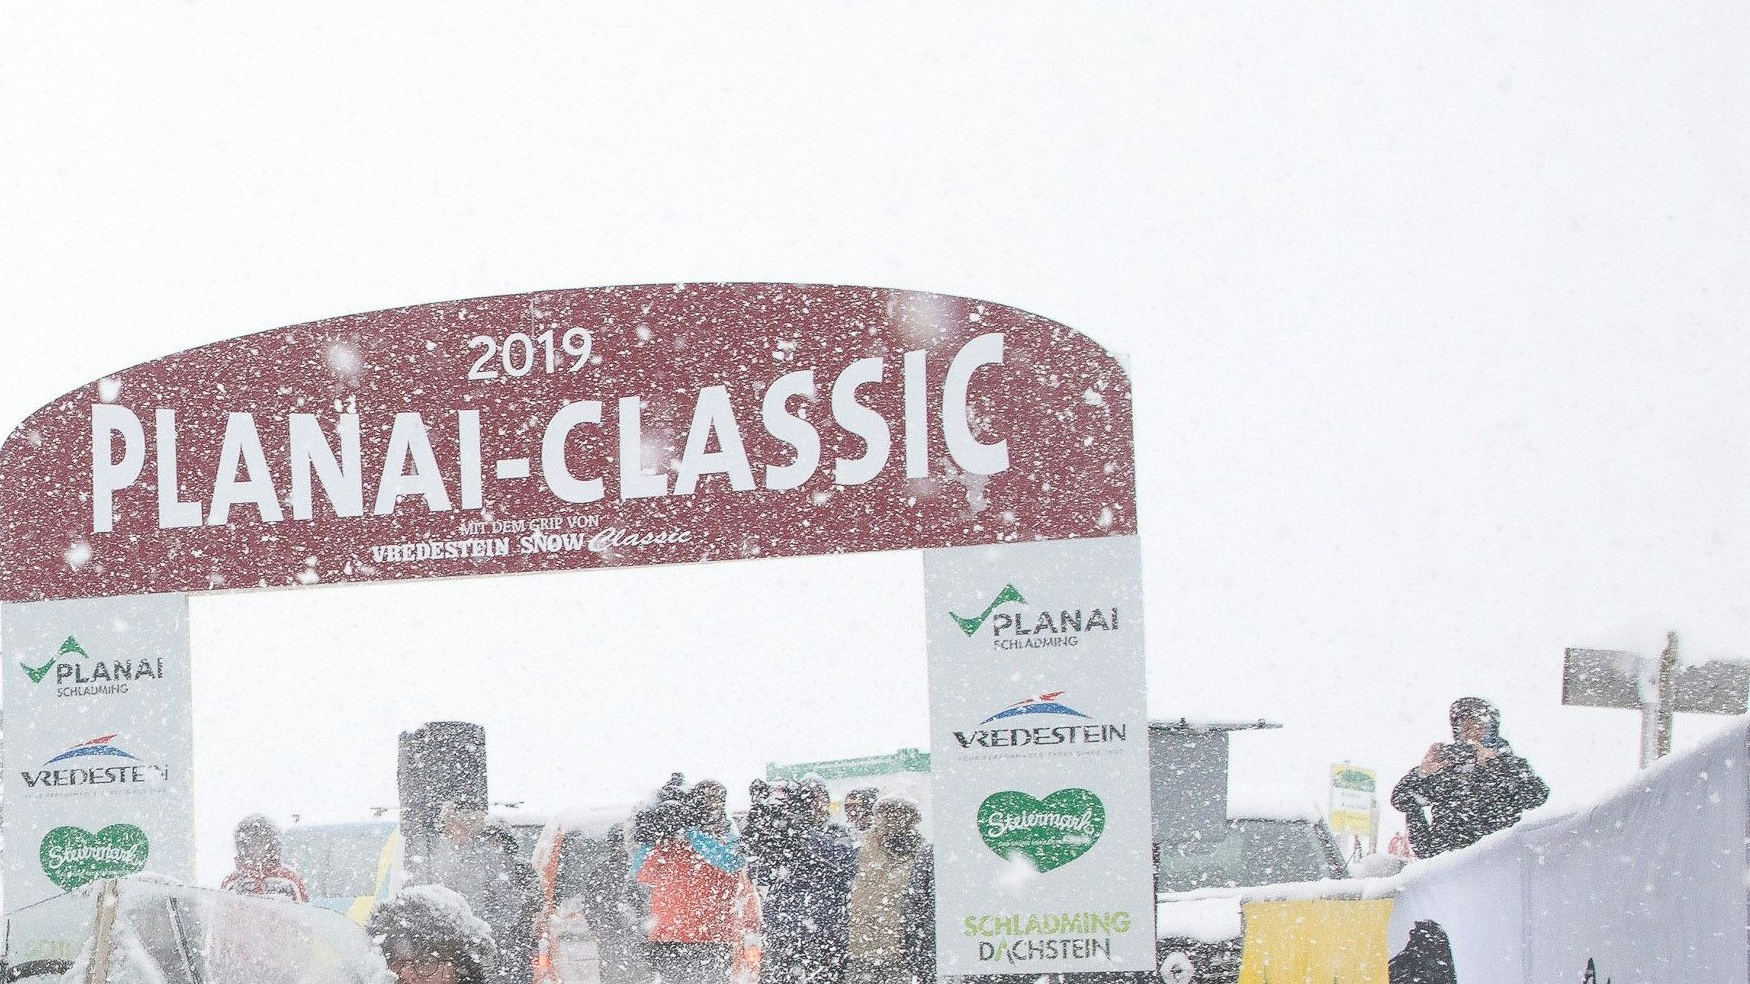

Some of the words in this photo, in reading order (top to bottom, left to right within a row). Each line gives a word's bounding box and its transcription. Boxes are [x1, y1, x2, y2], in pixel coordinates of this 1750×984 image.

[466, 329, 596, 381] 2019
[91, 333, 1011, 534] PLANAI-CLASSIC
[462, 522, 486, 535] MIT
[492, 520, 524, 533] DEM
[530, 517, 563, 531] GRIP
[569, 515, 600, 528] VON
[372, 537, 510, 563] VREDESTEIN
[519, 532, 586, 556] SNOW
[588, 526, 693, 552] Classic
[993, 607, 1119, 636] PLANAI
[993, 635, 1079, 651] SCHLADMING
[57, 657, 164, 684] PLANAI
[57, 683, 129, 698] SCHLADMING
[953, 723, 1127, 749] VREDESTEIN
[21, 764, 169, 789] VREDESTEN
[988, 807, 1096, 838] Steiermark
[963, 911, 1132, 938] SCHLADMING
[979, 937, 1112, 964] DACHSTEIN
